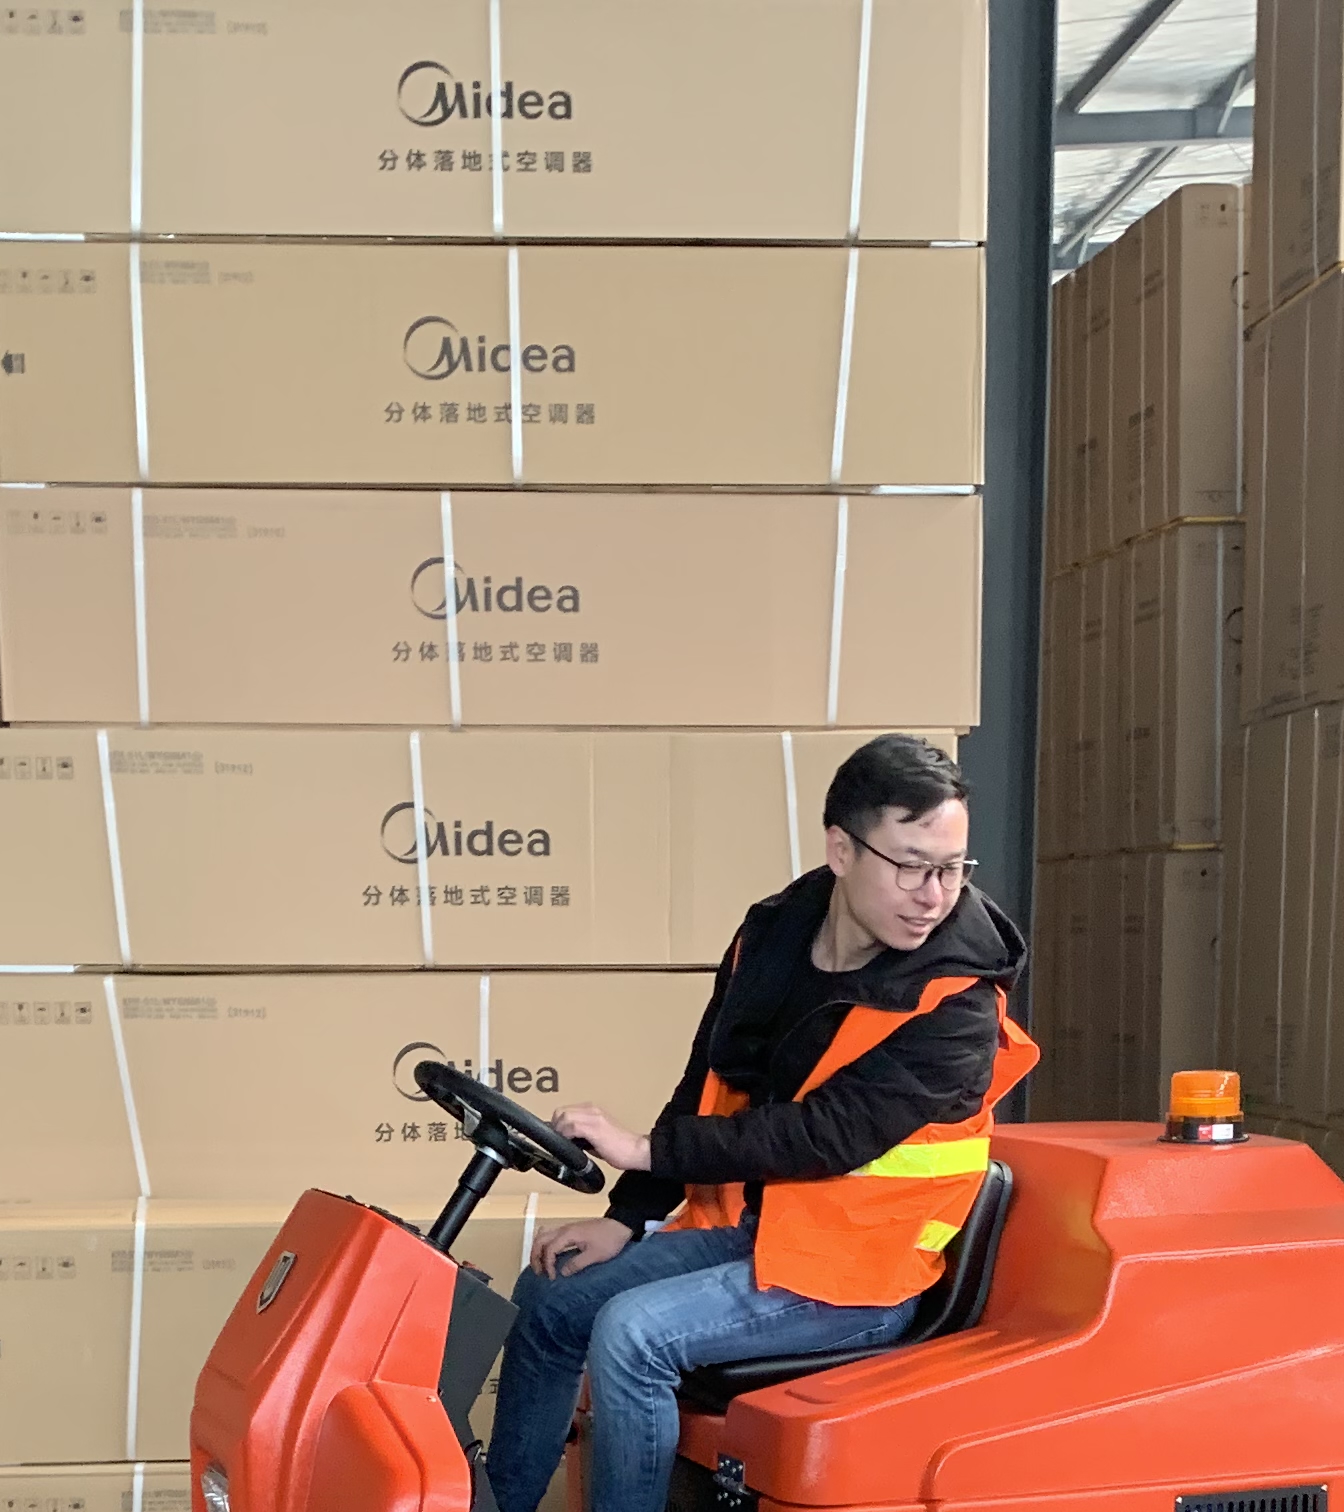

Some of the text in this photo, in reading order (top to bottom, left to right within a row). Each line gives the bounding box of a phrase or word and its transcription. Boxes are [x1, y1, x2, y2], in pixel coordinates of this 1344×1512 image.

[419, 81, 573, 127] Midea
[384, 403, 596, 426] 分体落地式空调器
[434, 576, 581, 619] Midea
[408, 820, 552, 858] Midea
[446, 1059, 560, 1093] idea
